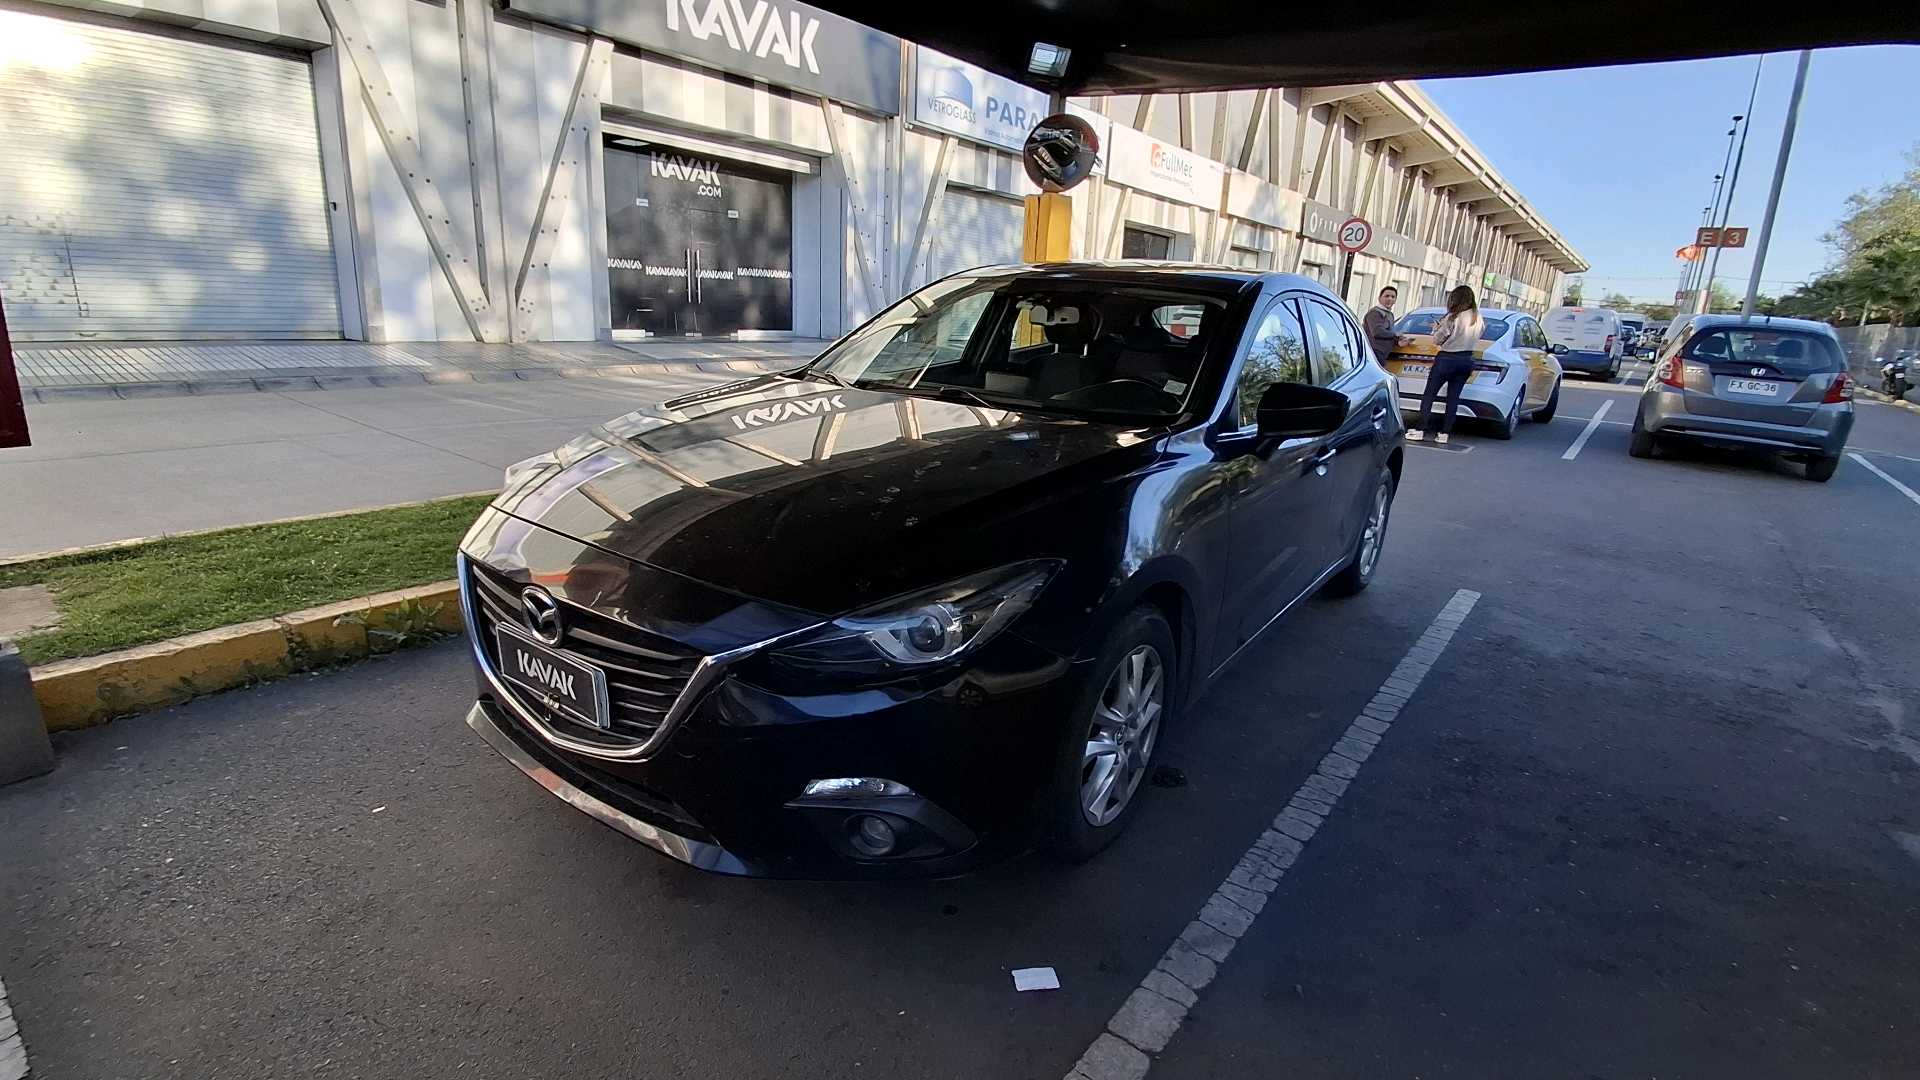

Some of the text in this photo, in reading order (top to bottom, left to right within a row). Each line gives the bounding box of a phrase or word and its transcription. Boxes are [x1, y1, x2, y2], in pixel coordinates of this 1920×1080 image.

[666, 0, 821, 75] KAVAK
[928, 95, 976, 124] VETROGLASS
[985, 96, 1047, 132] PARA
[651, 151, 721, 186] KAVAK
[697, 185, 722, 198] .COM
[1344, 227, 1365, 241] 20
[1701, 232, 1740, 245] E 3
[517, 649, 577, 701] KAVAK
